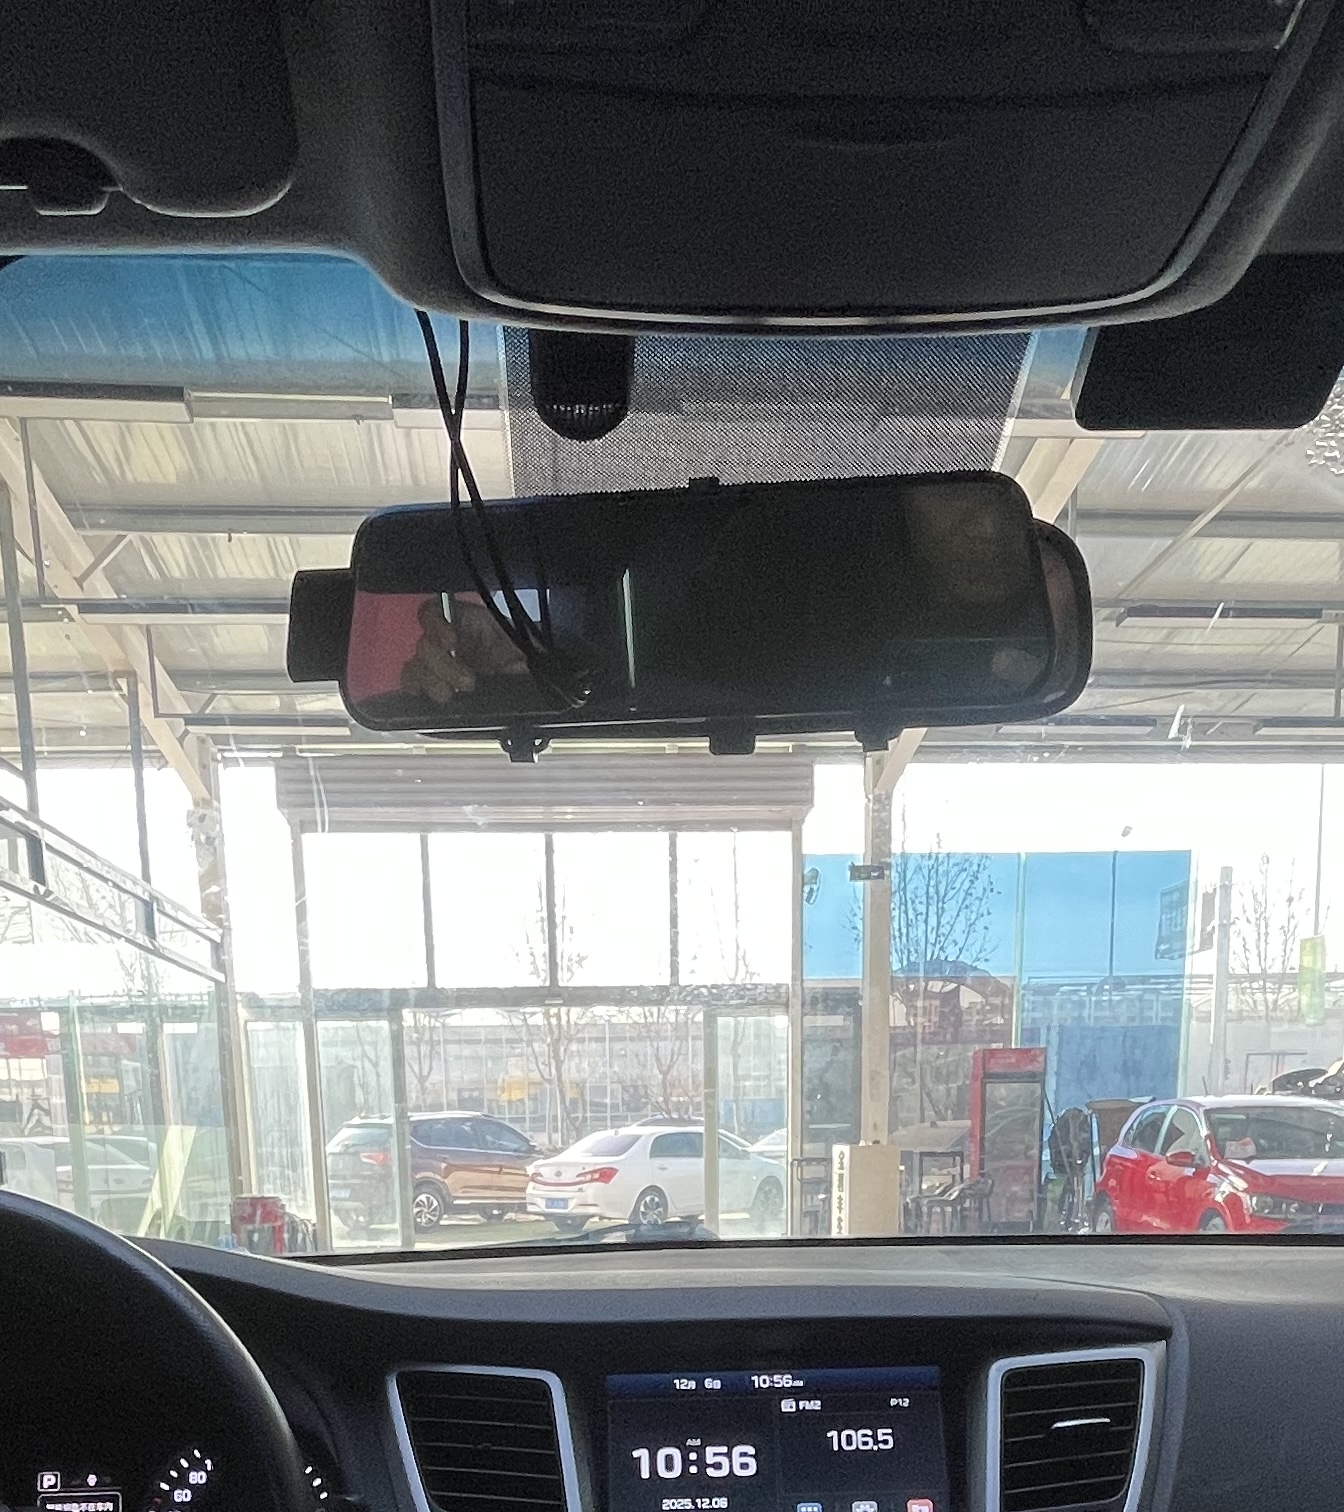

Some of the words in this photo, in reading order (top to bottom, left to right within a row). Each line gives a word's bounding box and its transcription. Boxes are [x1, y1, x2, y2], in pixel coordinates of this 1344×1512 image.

[751, 1374, 793, 1388] 10:56
[798, 1400, 822, 1410] FM2
[889, 1398, 910, 1407] P12
[827, 1428, 894, 1451] 106.5
[632, 1445, 758, 1479] 10:56
[43, 1475, 56, 1488] P
[189, 1471, 207, 1485] 80
[174, 1489, 192, 1503] 60
